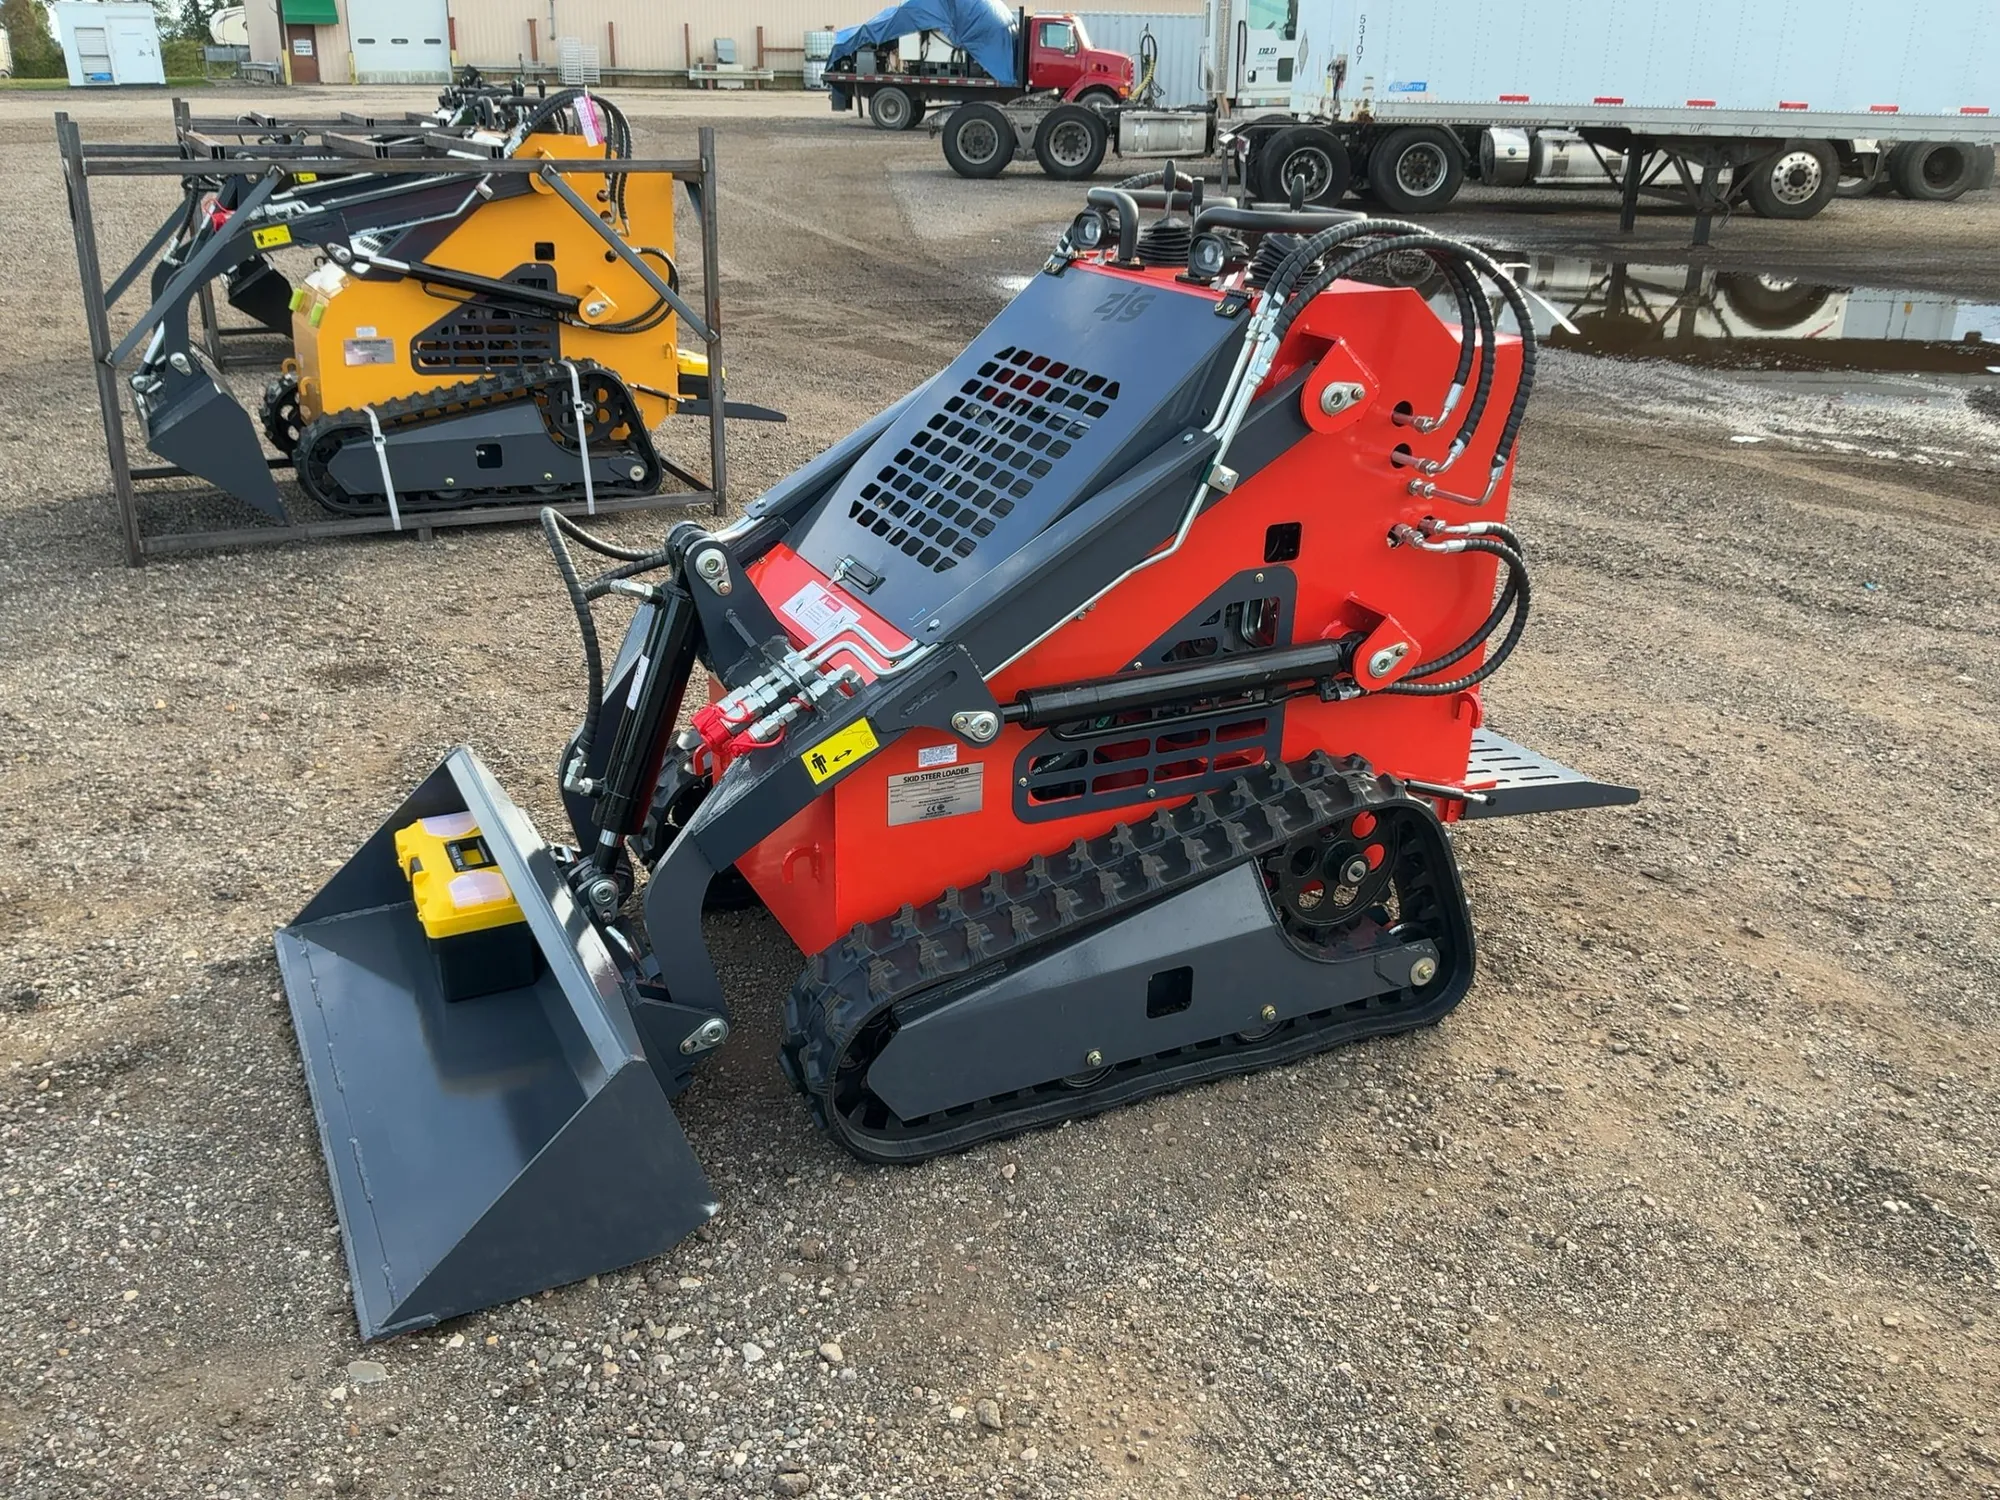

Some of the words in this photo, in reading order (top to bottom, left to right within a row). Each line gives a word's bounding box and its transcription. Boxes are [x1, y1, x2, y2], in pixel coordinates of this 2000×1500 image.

[1356, 14, 1366, 65] 53107
[903, 775, 920, 783] SKID
[920, 772, 941, 781] STEER
[942, 767, 970, 777] LOADER
